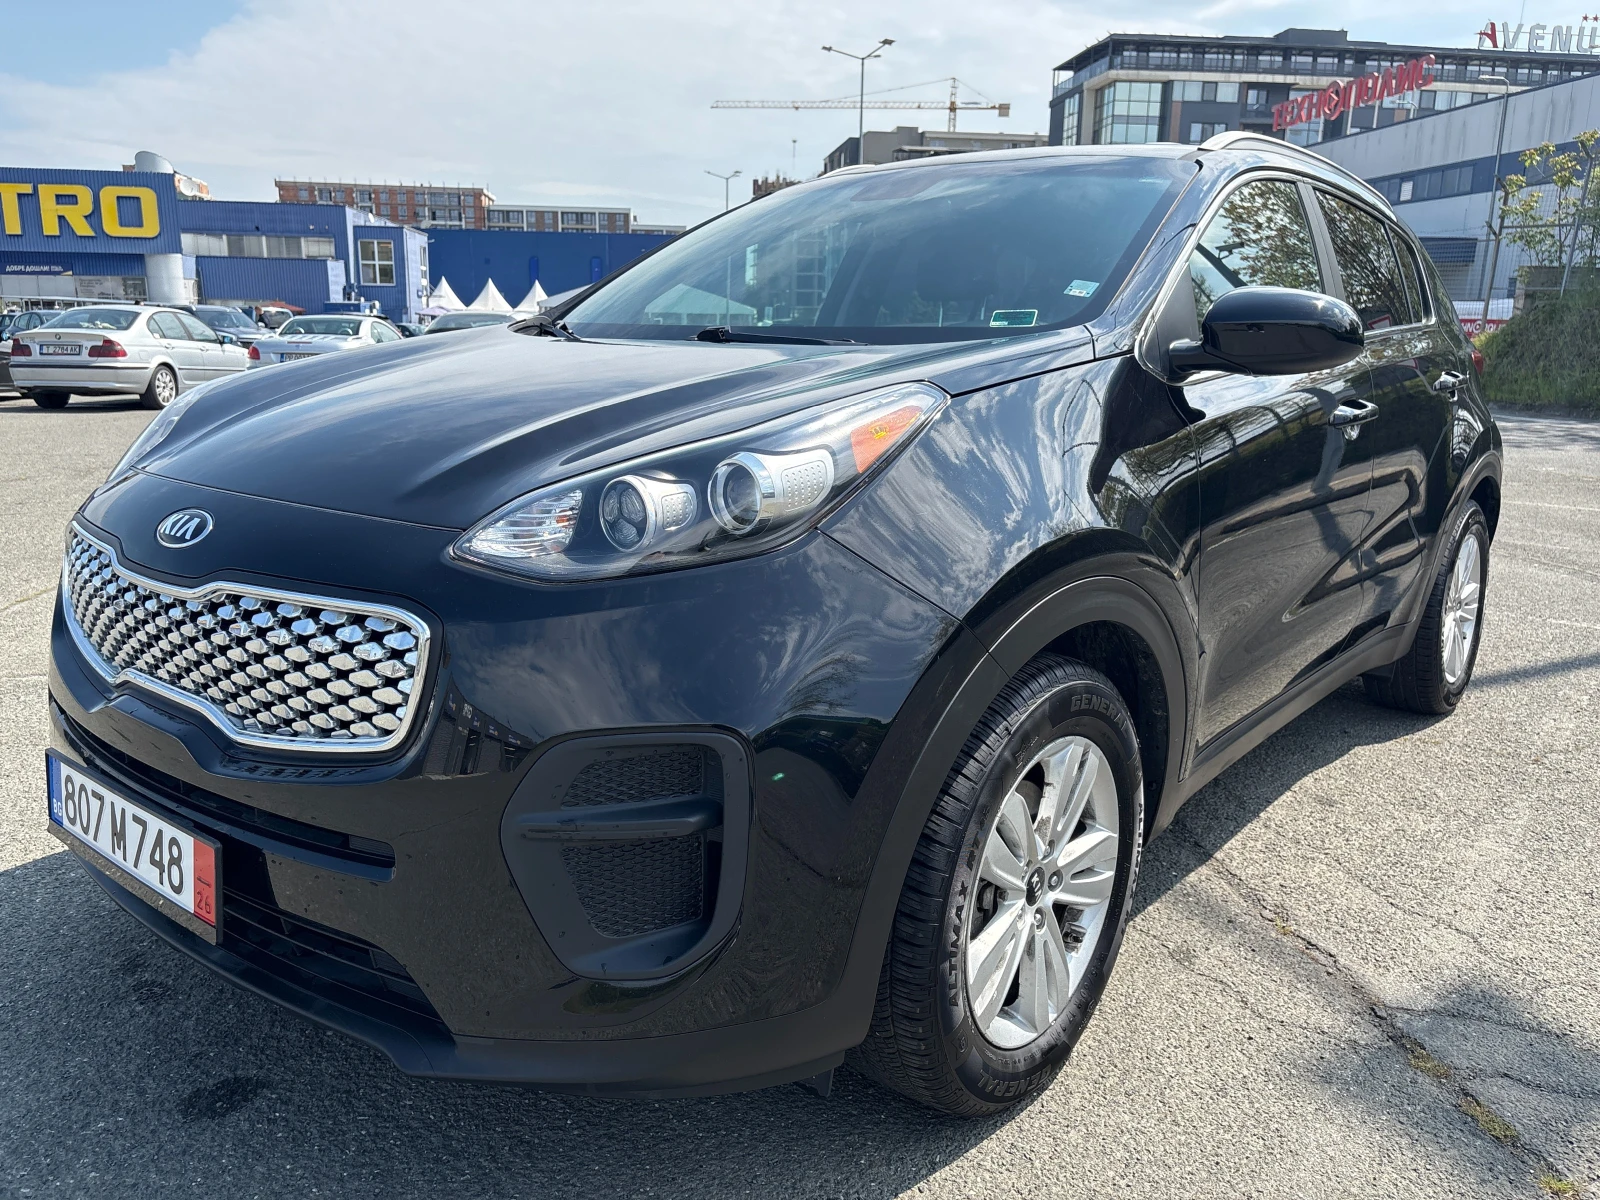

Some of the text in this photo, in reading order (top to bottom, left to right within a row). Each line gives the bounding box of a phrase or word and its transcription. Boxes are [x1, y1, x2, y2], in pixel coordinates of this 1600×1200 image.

[1271, 54, 1436, 132] ТЕХНОПОЛИС
[160, 514, 201, 540] KIA
[1070, 694, 1128, 738] GENERAL
[53, 798, 63, 817] BG
[64, 774, 184, 895] 807 M 748
[948, 880, 969, 1007] ALTIMAX
[977, 1065, 1053, 1098] GENERAL
